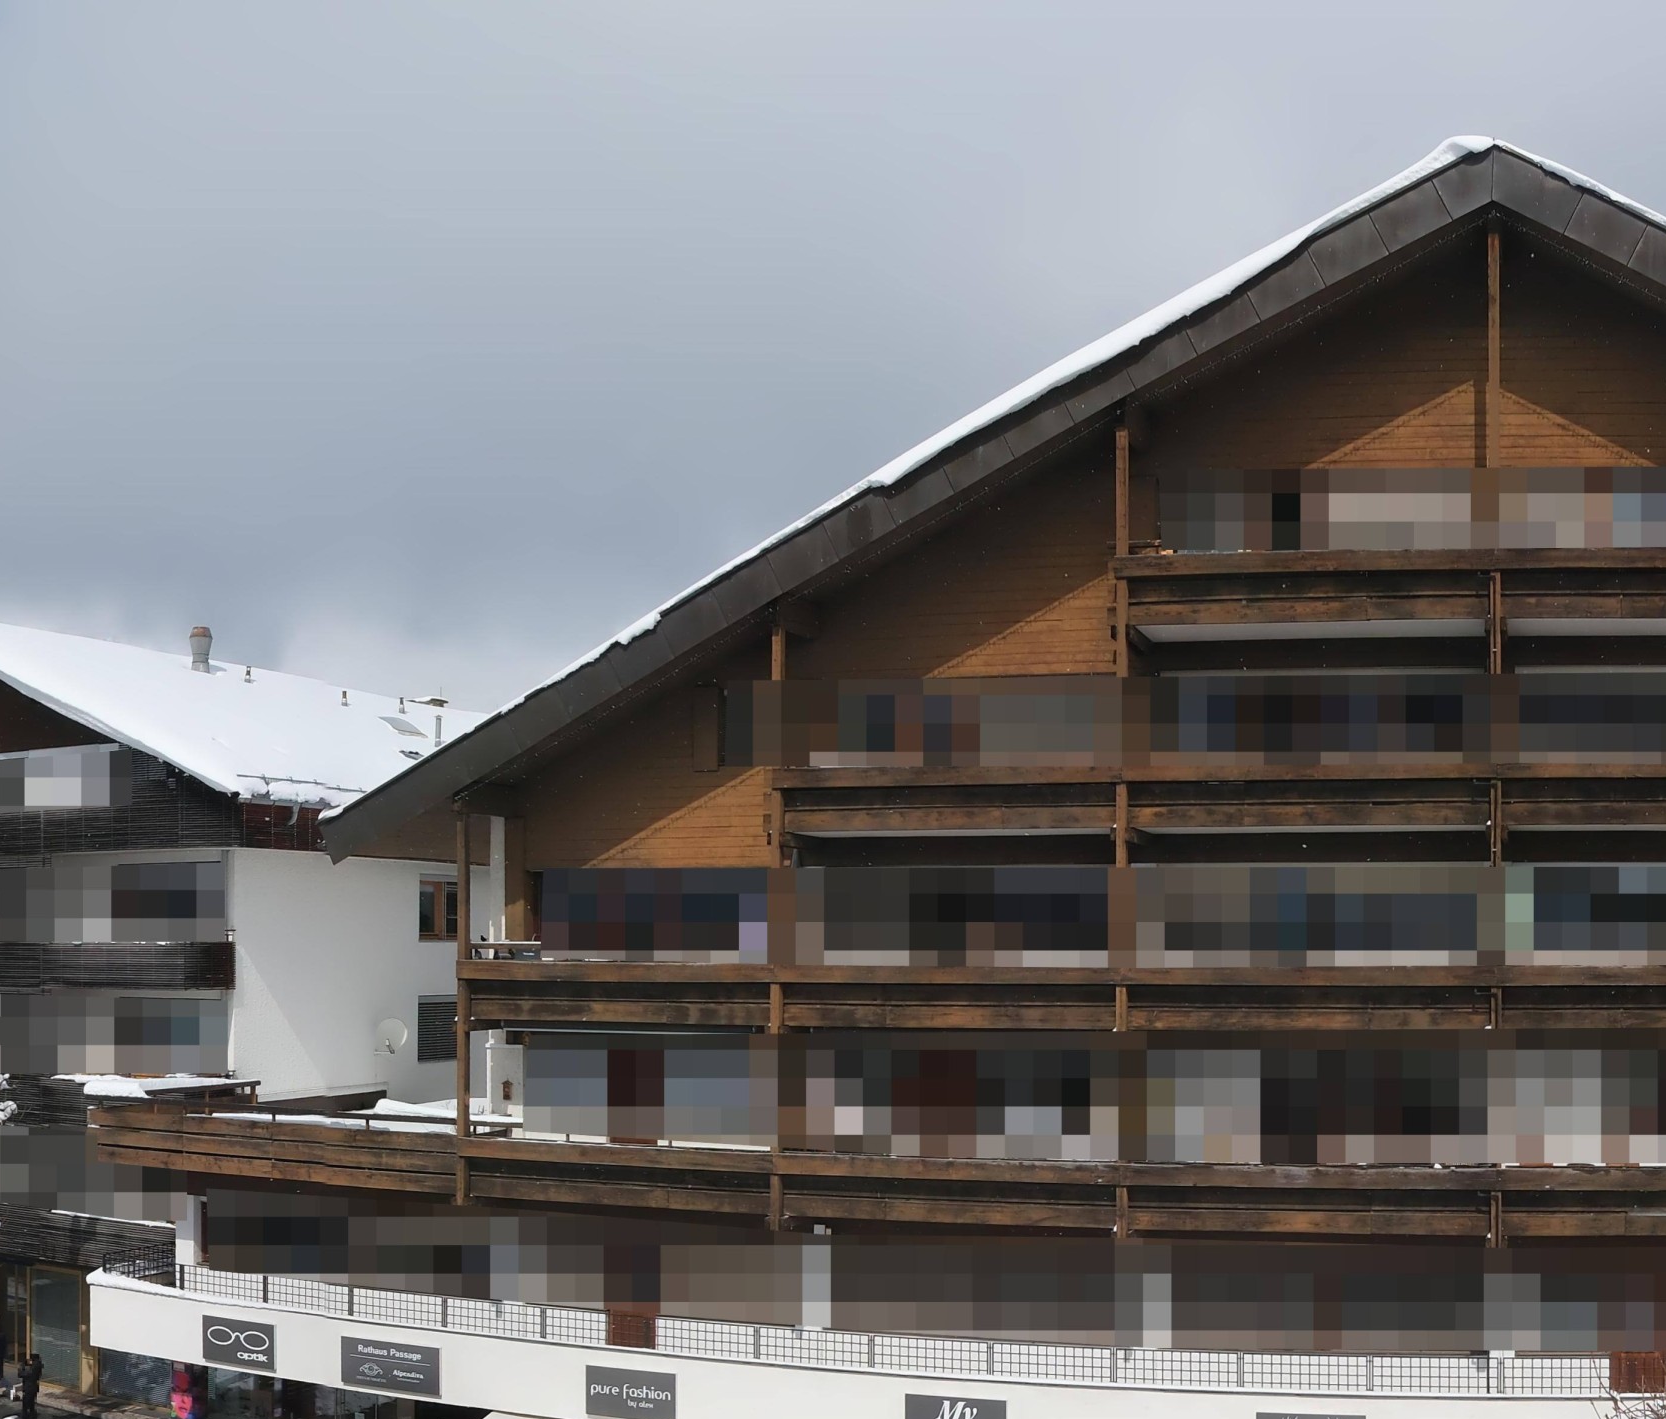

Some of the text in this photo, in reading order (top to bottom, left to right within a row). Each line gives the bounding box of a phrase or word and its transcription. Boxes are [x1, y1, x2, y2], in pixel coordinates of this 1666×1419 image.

[237, 1352, 268, 1363] optik
[358, 1344, 422, 1361] Rathaus Passage
[590, 1383, 671, 1401] pure fashion
[627, 1399, 637, 1409] by
